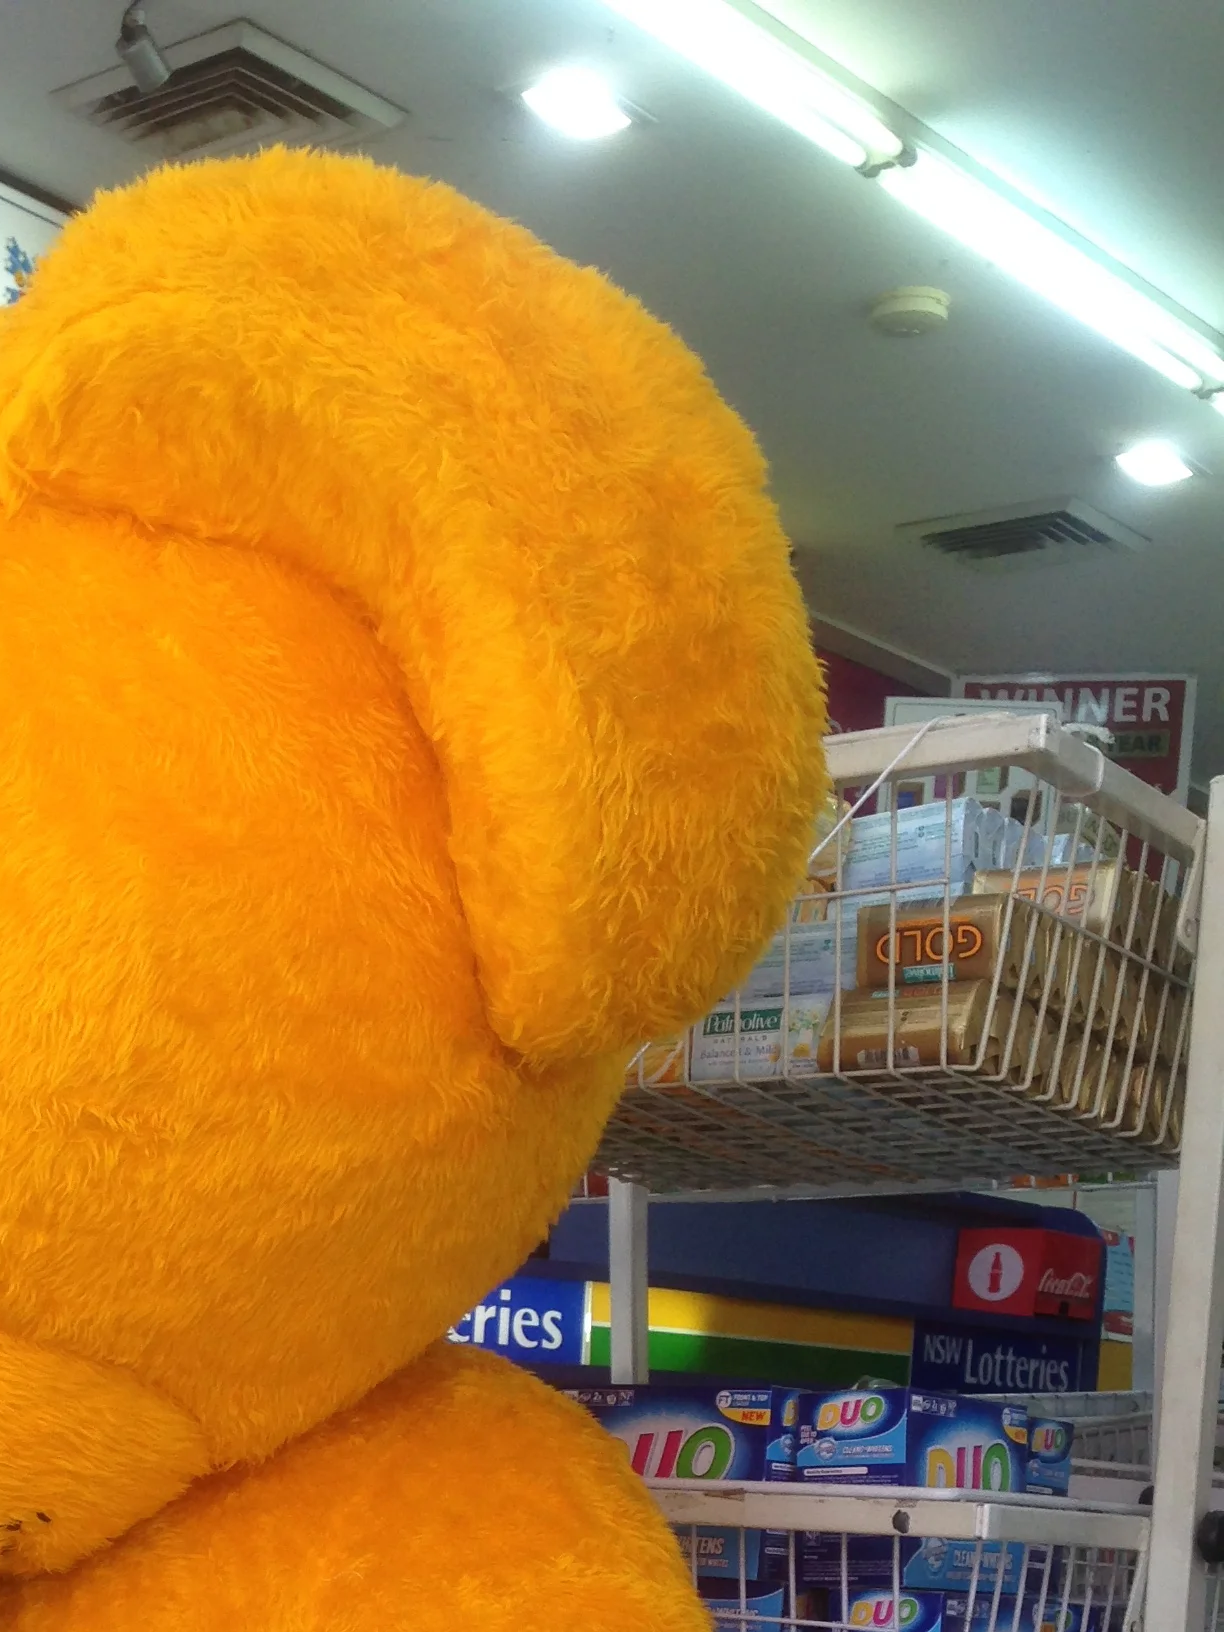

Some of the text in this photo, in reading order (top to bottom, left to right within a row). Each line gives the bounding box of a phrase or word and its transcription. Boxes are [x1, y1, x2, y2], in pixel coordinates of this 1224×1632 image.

[875, 923, 983, 965] GOLD
[903, 964, 954, 981] Plmolive
[713, 1035, 768, 1044] NATRALS
[924, 1333, 1070, 1392] NSW Lotteries
[741, 1411, 766, 1422] NEW
[816, 1395, 886, 1431] DUO
[631, 1424, 736, 1481] UO
[1032, 1427, 1067, 1451] DUO
[927, 1440, 1012, 1491] DUO
[850, 1598, 918, 1627] DUO
